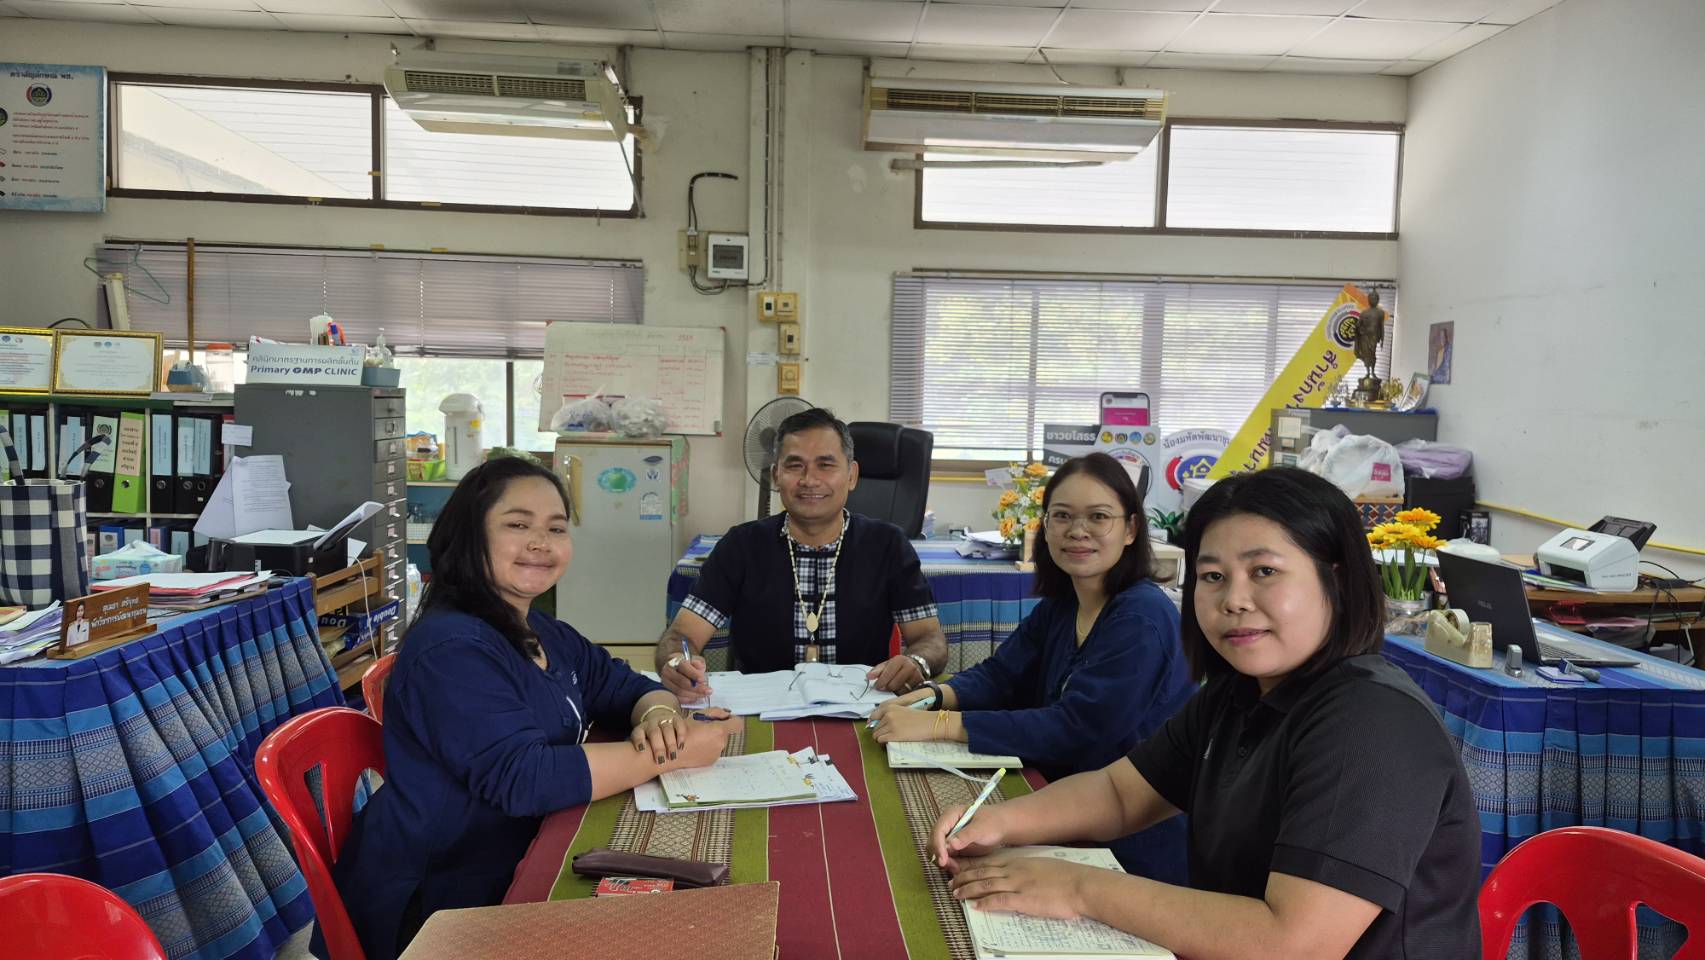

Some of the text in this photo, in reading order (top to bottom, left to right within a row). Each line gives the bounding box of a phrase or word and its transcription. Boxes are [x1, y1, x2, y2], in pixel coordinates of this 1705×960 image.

[250, 365, 290, 375] Primary
[324, 367, 358, 375] CLINIC
[1046, 430, 1096, 441] ชาวยโสธร
